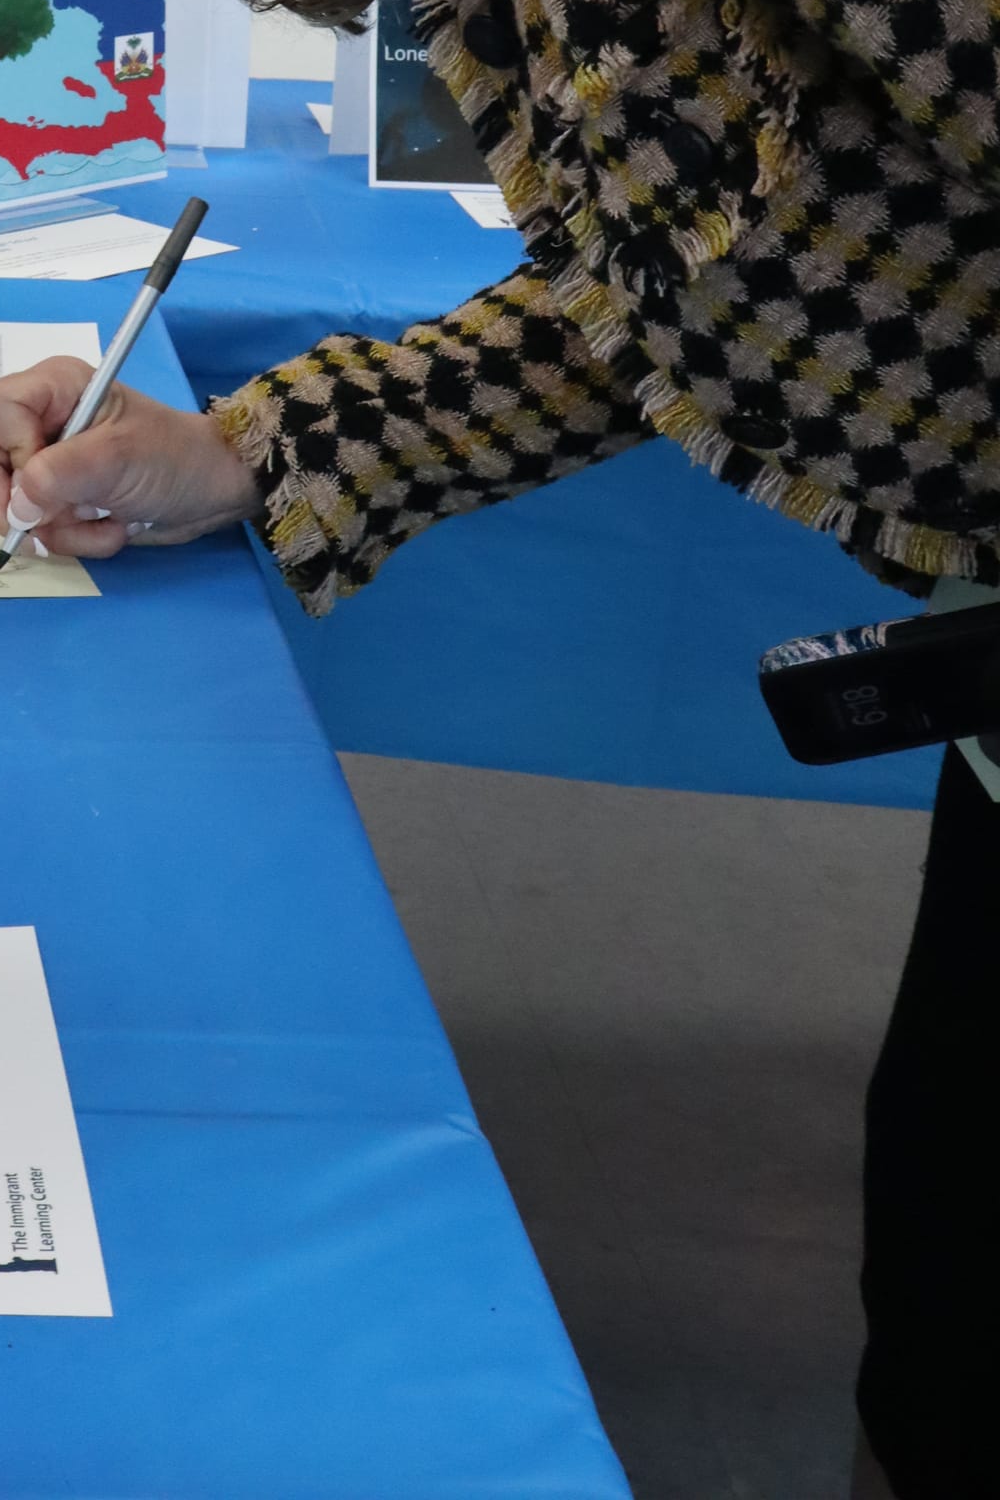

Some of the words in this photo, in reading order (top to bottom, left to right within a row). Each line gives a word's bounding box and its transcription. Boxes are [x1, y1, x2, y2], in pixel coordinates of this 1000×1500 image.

[4, 1173, 25, 1228] Immigrant
[29, 1167, 46, 1201] Center
[12, 1231, 28, 1252] The
[34, 1204, 54, 1251] Learning
